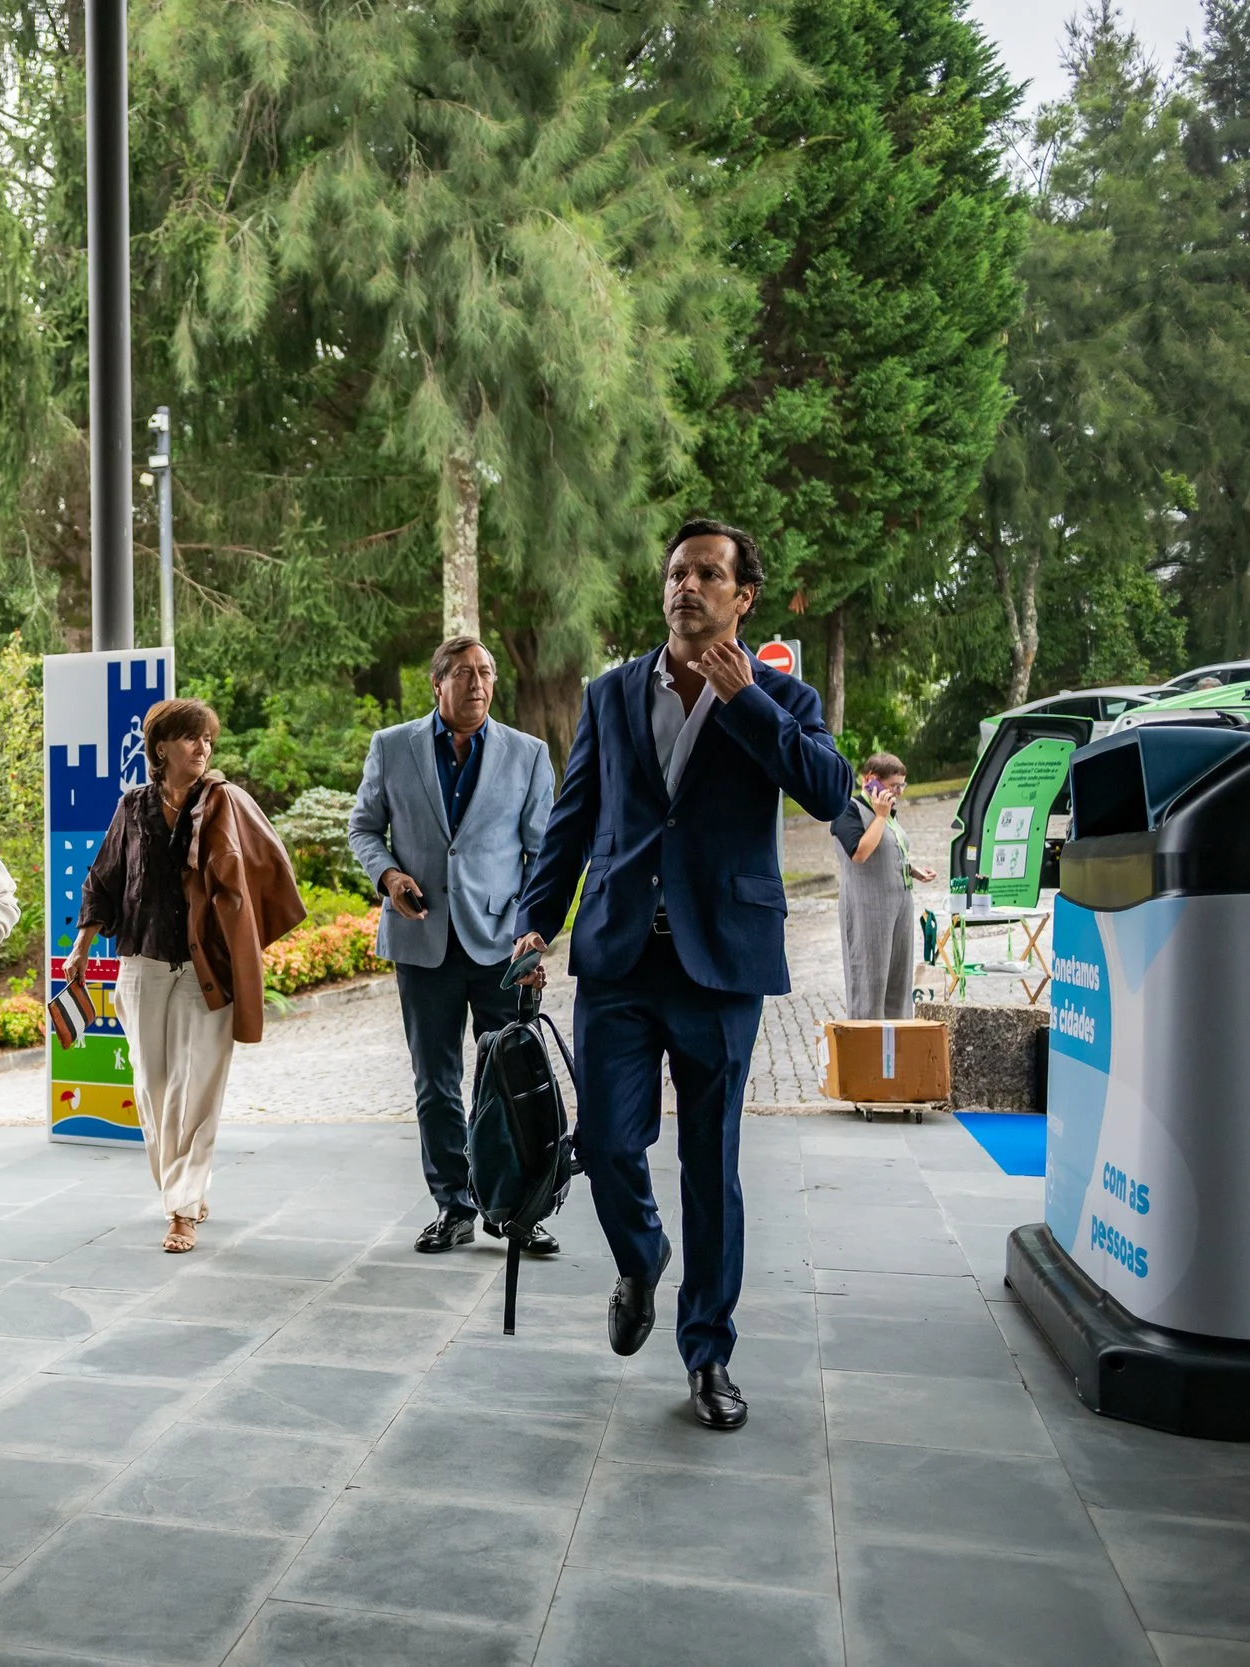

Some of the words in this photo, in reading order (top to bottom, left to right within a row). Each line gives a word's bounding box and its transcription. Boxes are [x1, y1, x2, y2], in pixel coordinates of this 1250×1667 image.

[1059, 998, 1095, 1044] cidades
[1103, 1161, 1126, 1203] com
[1129, 1179, 1150, 1215] as
[1091, 1214, 1148, 1278] pessoas
